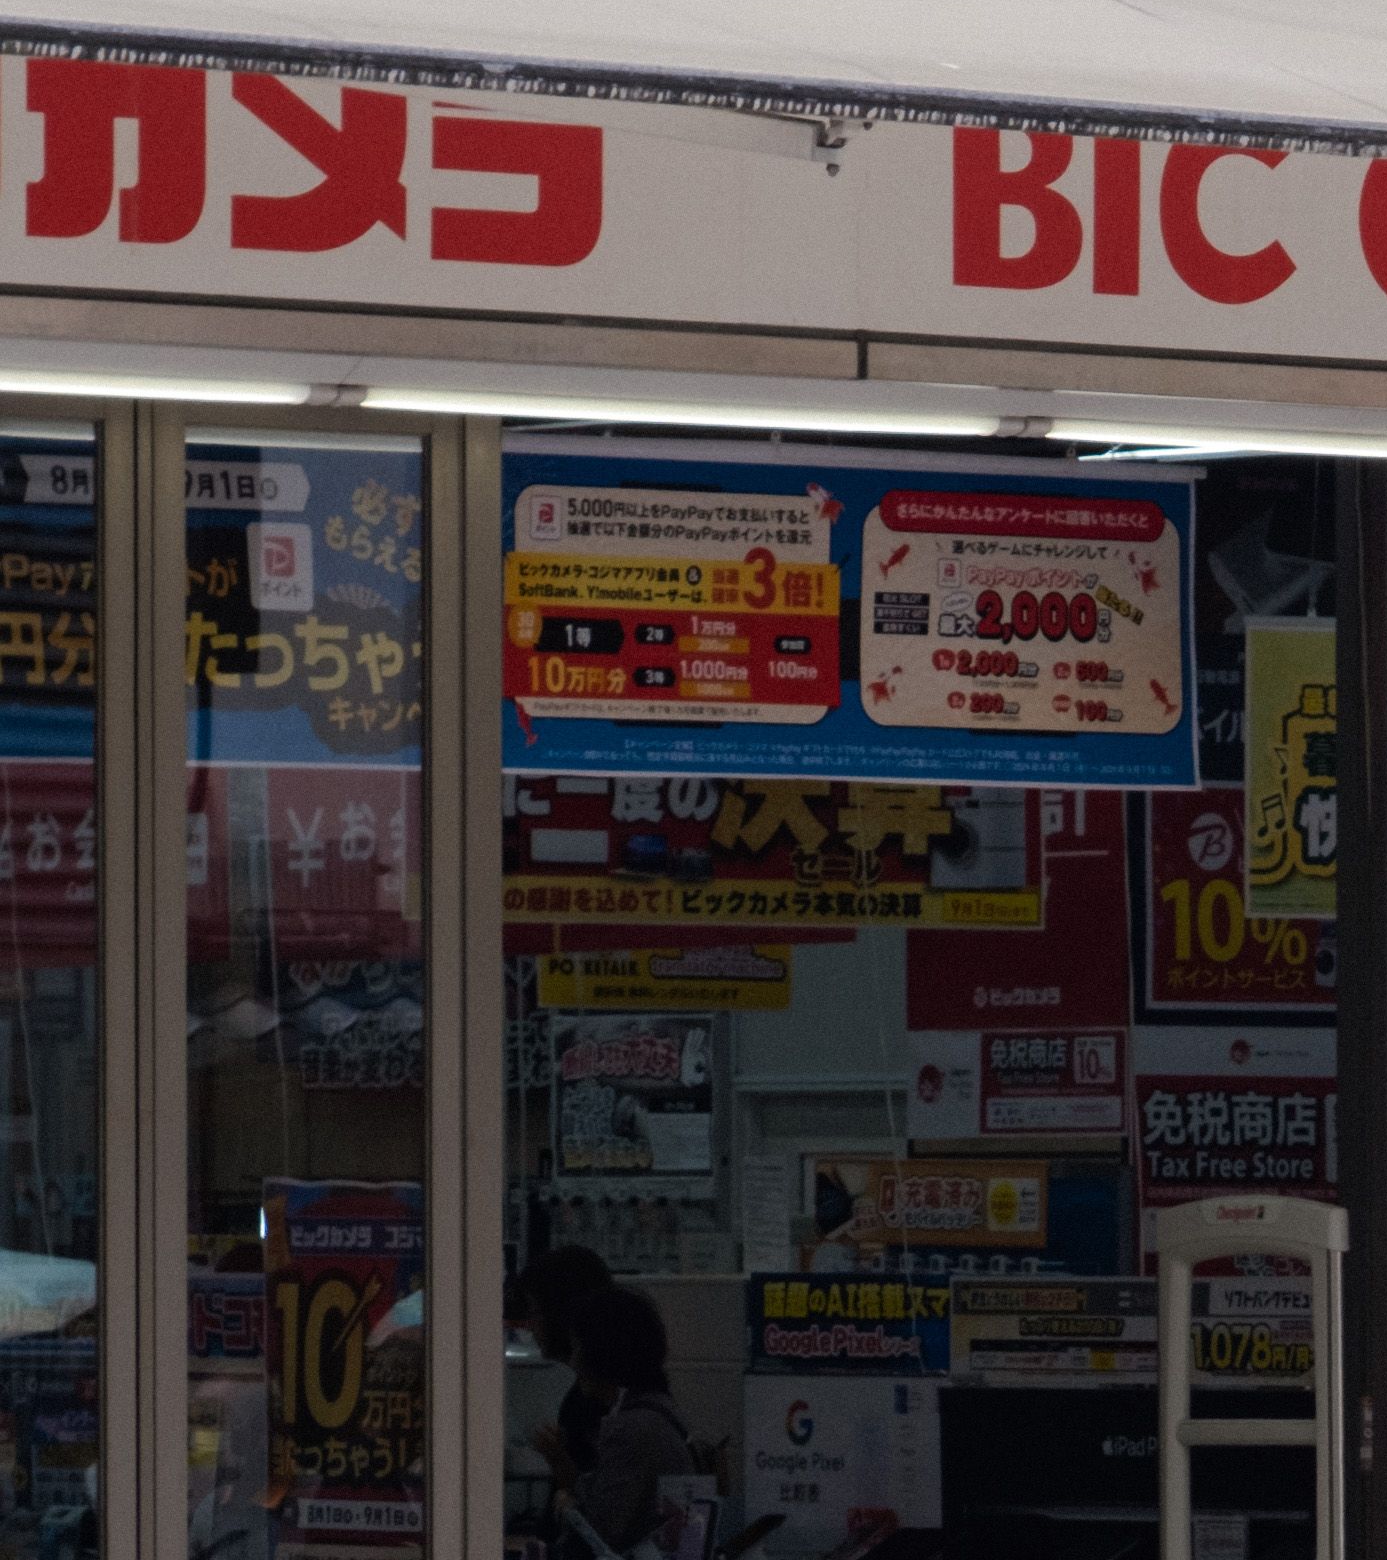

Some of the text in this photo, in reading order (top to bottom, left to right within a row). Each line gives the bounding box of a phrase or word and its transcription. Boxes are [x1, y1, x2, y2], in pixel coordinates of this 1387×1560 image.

[952, 125, 1298, 306] BIC
[976, 589, 1098, 645] 2,000
[186, 610, 421, 696] たっちゃ
[1142, 1090, 1317, 1148] 免税商店
[1147, 1150, 1314, 1180] Tax Free Store
